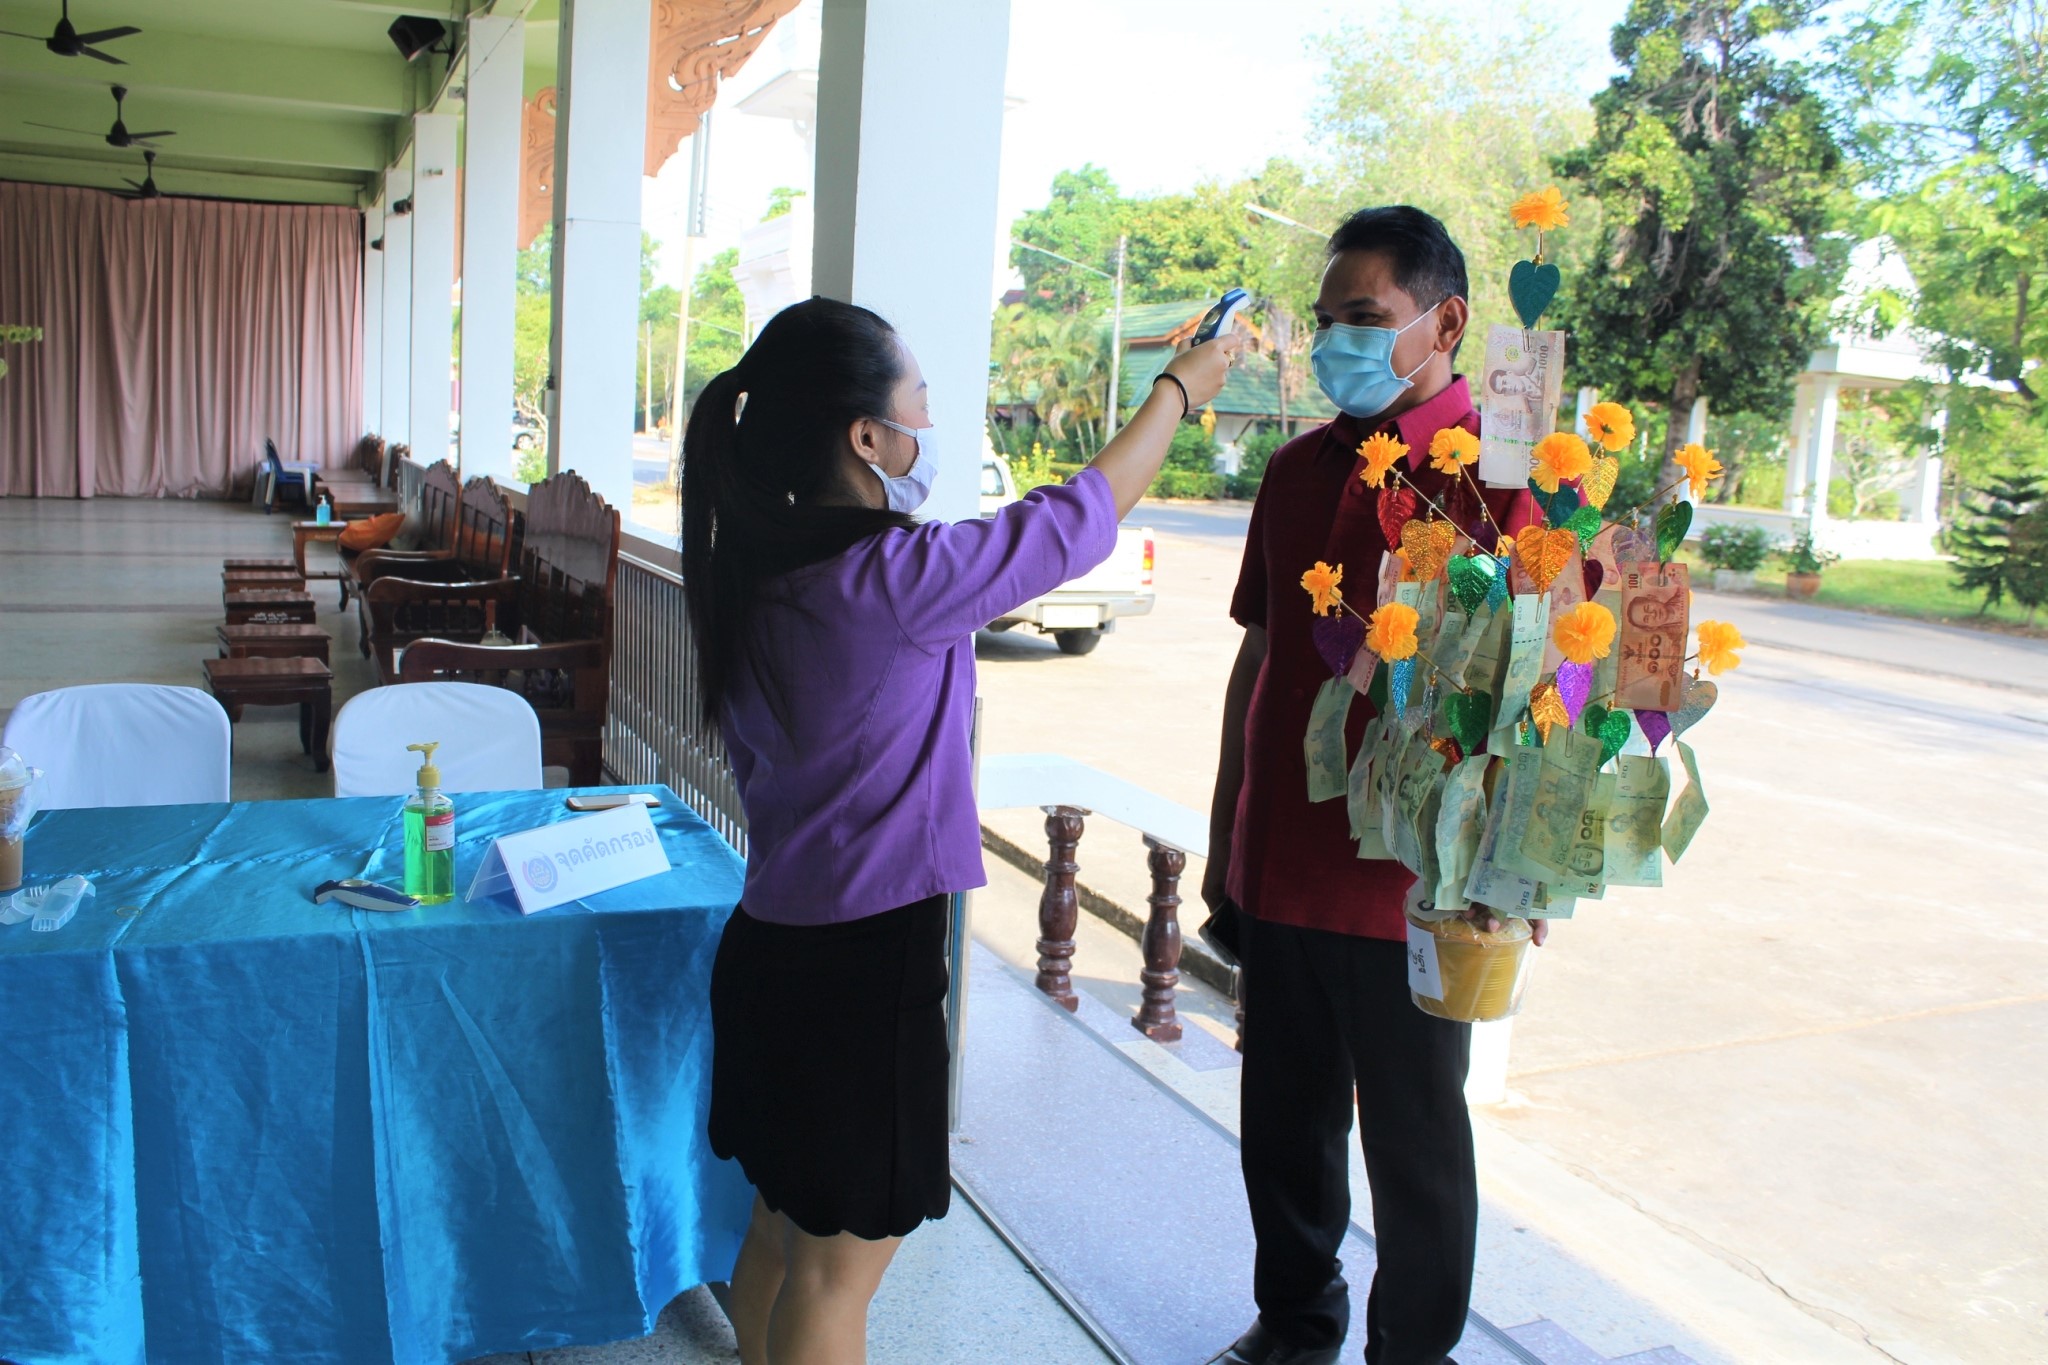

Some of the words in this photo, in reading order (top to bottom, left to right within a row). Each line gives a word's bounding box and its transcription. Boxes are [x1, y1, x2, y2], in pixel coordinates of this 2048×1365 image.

[1538, 345, 1549, 370] 1000
[1628, 573, 1639, 590] 100
[554, 827, 656, 873] จุดคัดกรอง
[1587, 882, 1599, 894] 20
